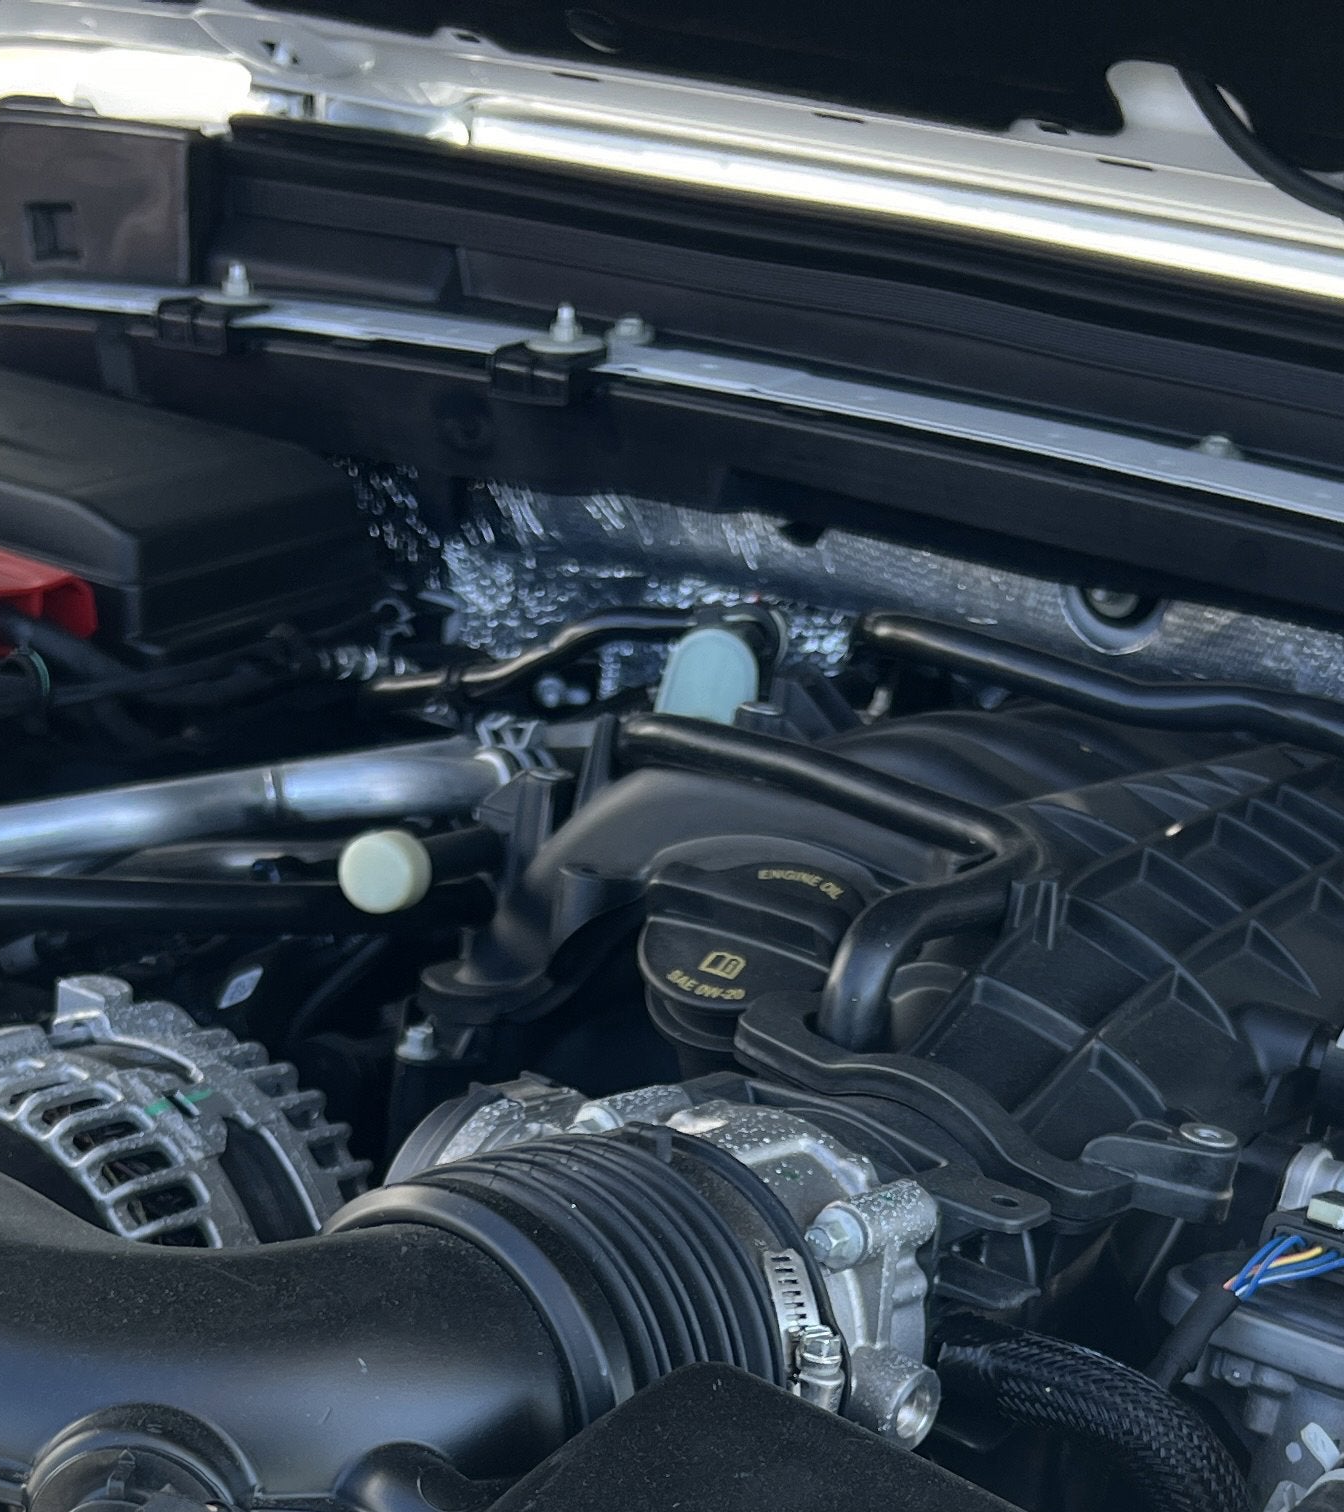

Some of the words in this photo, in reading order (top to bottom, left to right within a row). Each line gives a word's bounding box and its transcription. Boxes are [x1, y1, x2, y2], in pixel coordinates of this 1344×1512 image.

[757, 869, 823, 887] ENGINE
[819, 881, 845, 900] OIL
[666, 969, 696, 992] SAE
[694, 983, 746, 1000] 0W-20
